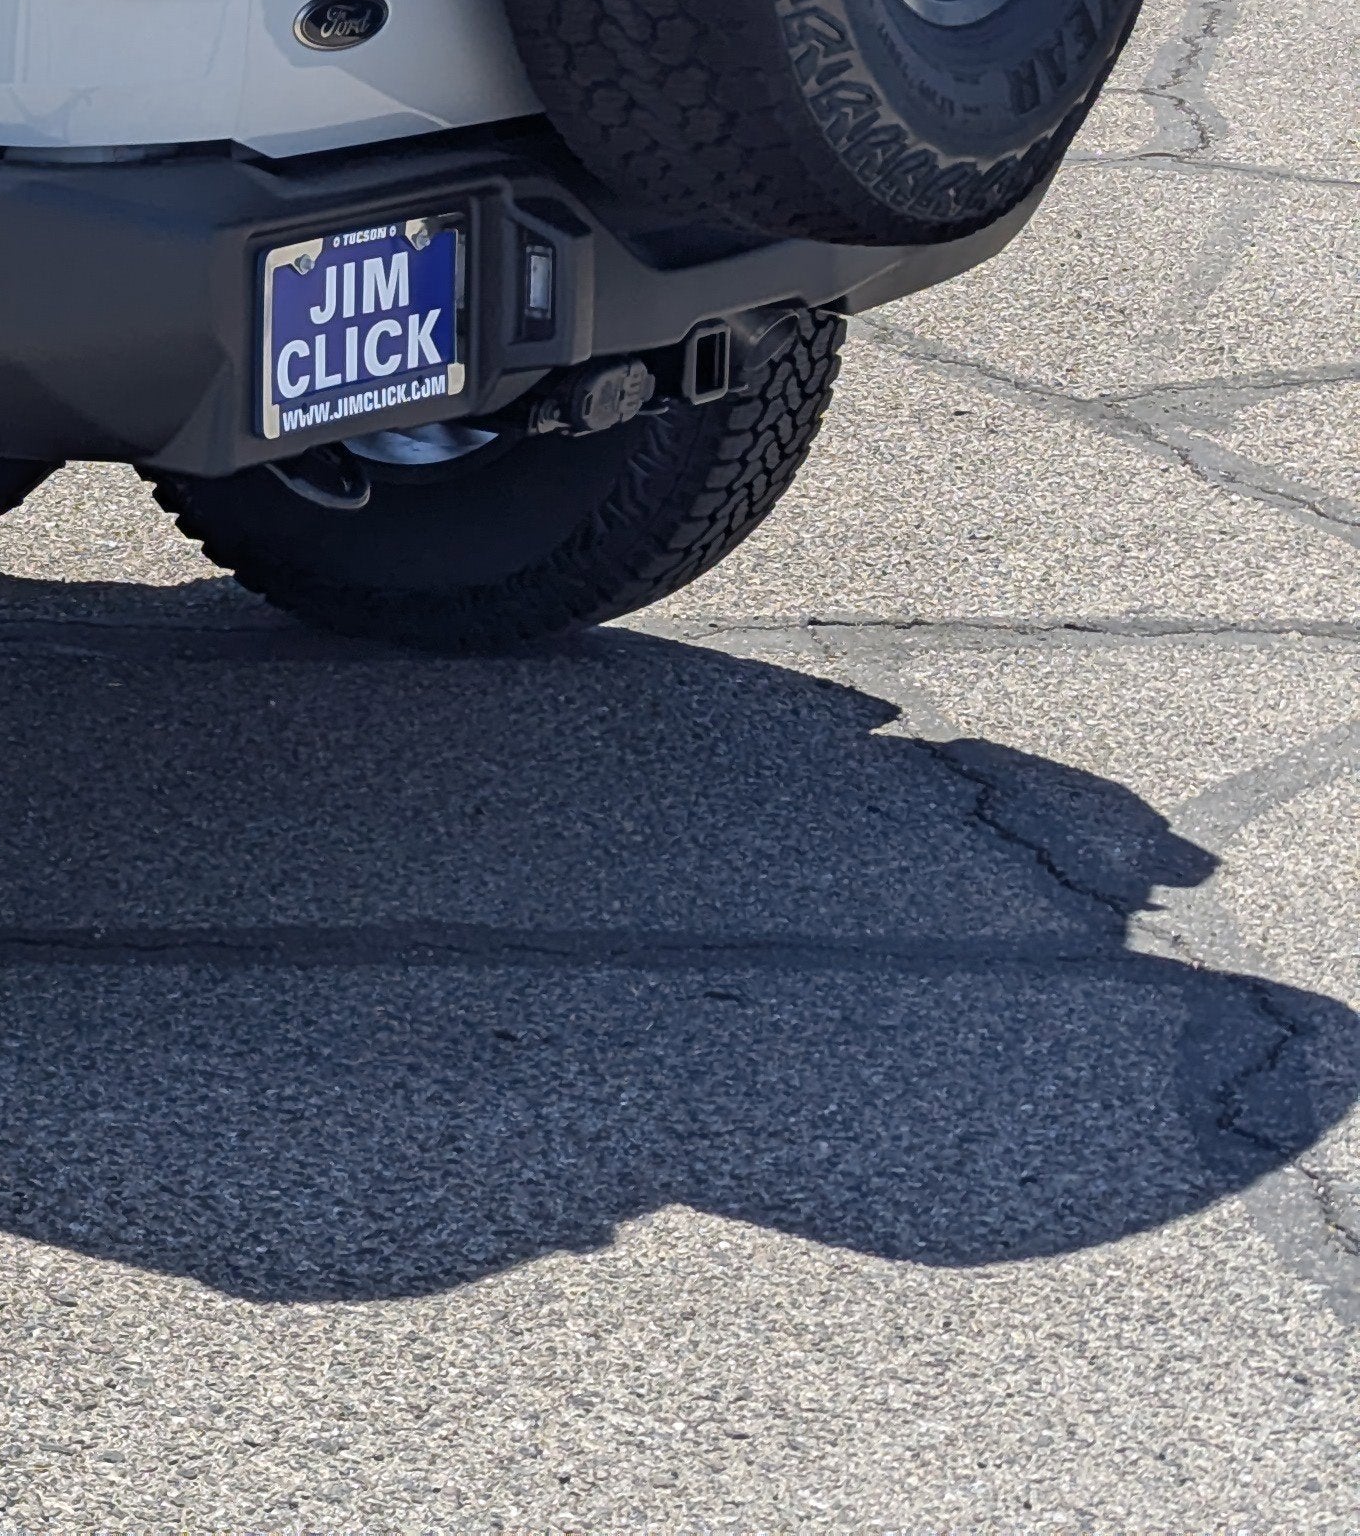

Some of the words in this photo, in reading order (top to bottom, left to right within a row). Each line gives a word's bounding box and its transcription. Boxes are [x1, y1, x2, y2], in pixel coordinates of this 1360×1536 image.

[320, 5, 373, 38] Ford
[343, 226, 388, 248] TUCSON
[309, 251, 410, 325] JIM
[277, 308, 442, 399] CLICK
[282, 374, 446, 433] WWW.JIMCLICK.COM
